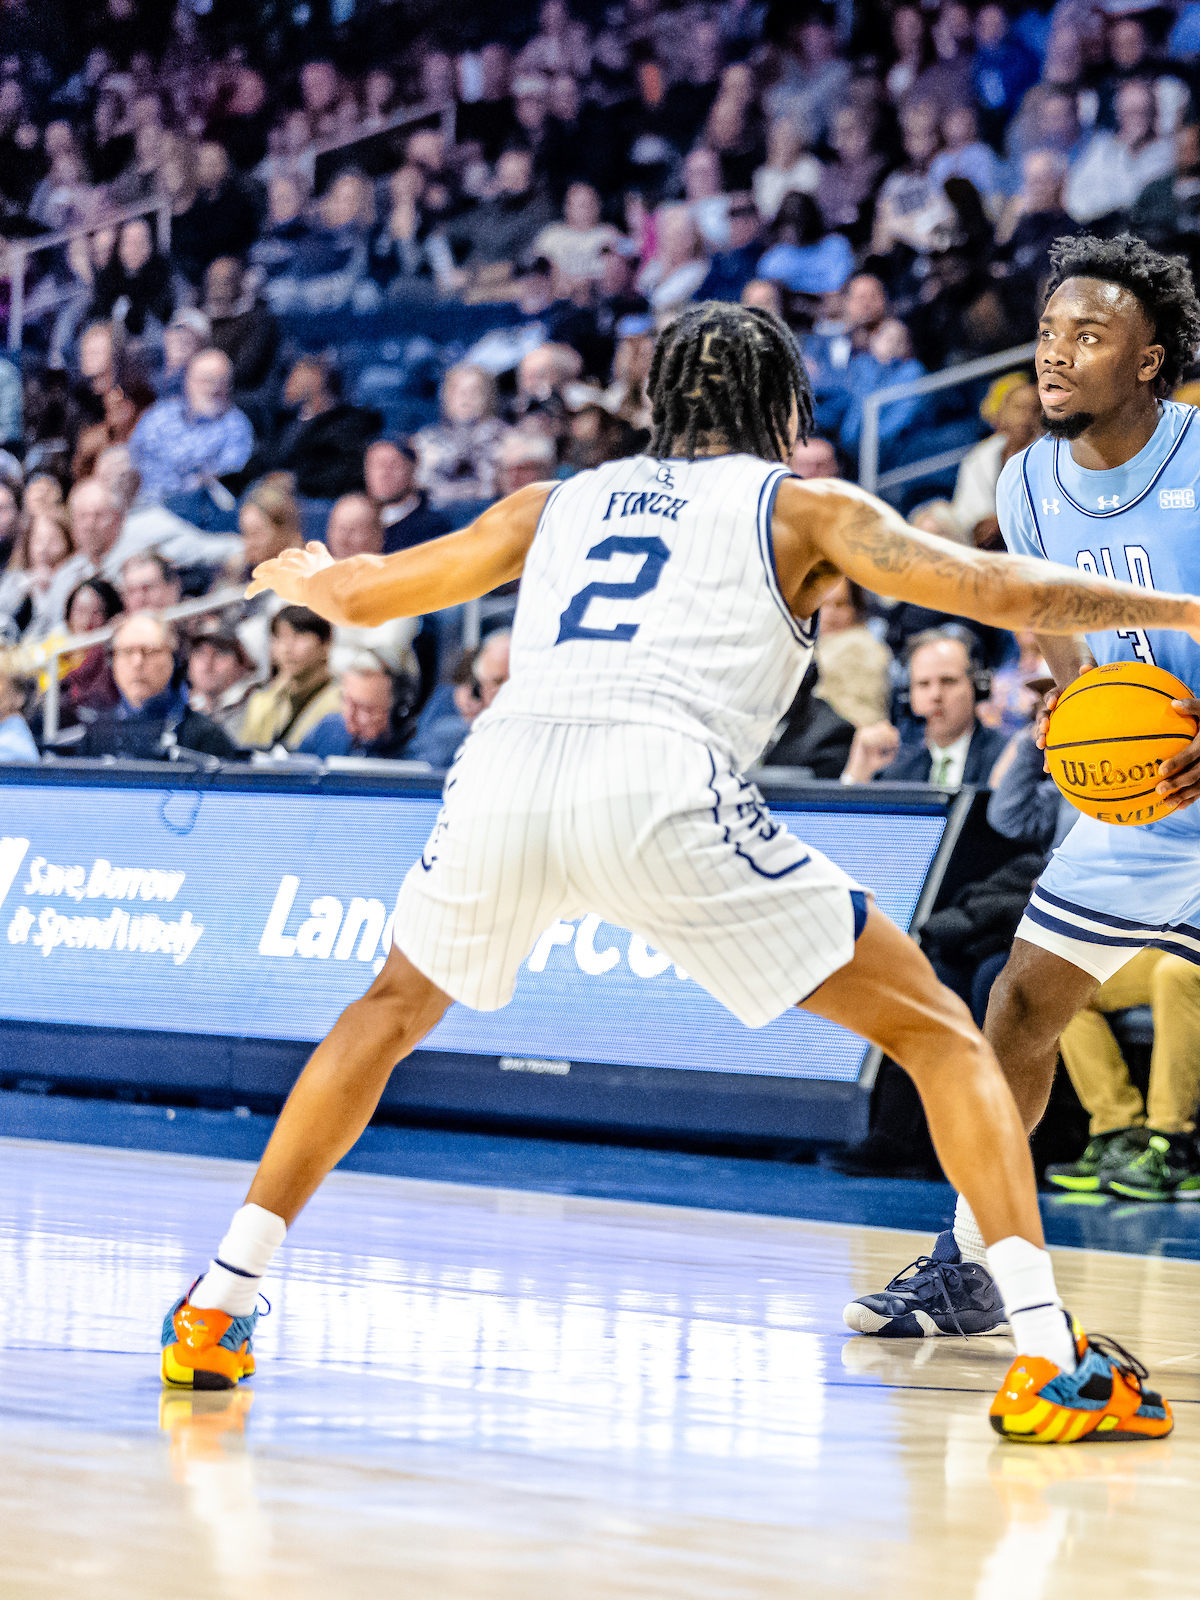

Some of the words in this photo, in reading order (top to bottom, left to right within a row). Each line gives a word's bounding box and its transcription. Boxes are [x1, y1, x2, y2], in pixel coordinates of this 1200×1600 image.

[602, 491, 690, 522] FINCH
[1160, 489, 1195, 509] SBC
[554, 535, 672, 646] 2
[1060, 757, 1164, 787] Wilson
[1096, 804, 1155, 823] EVO
